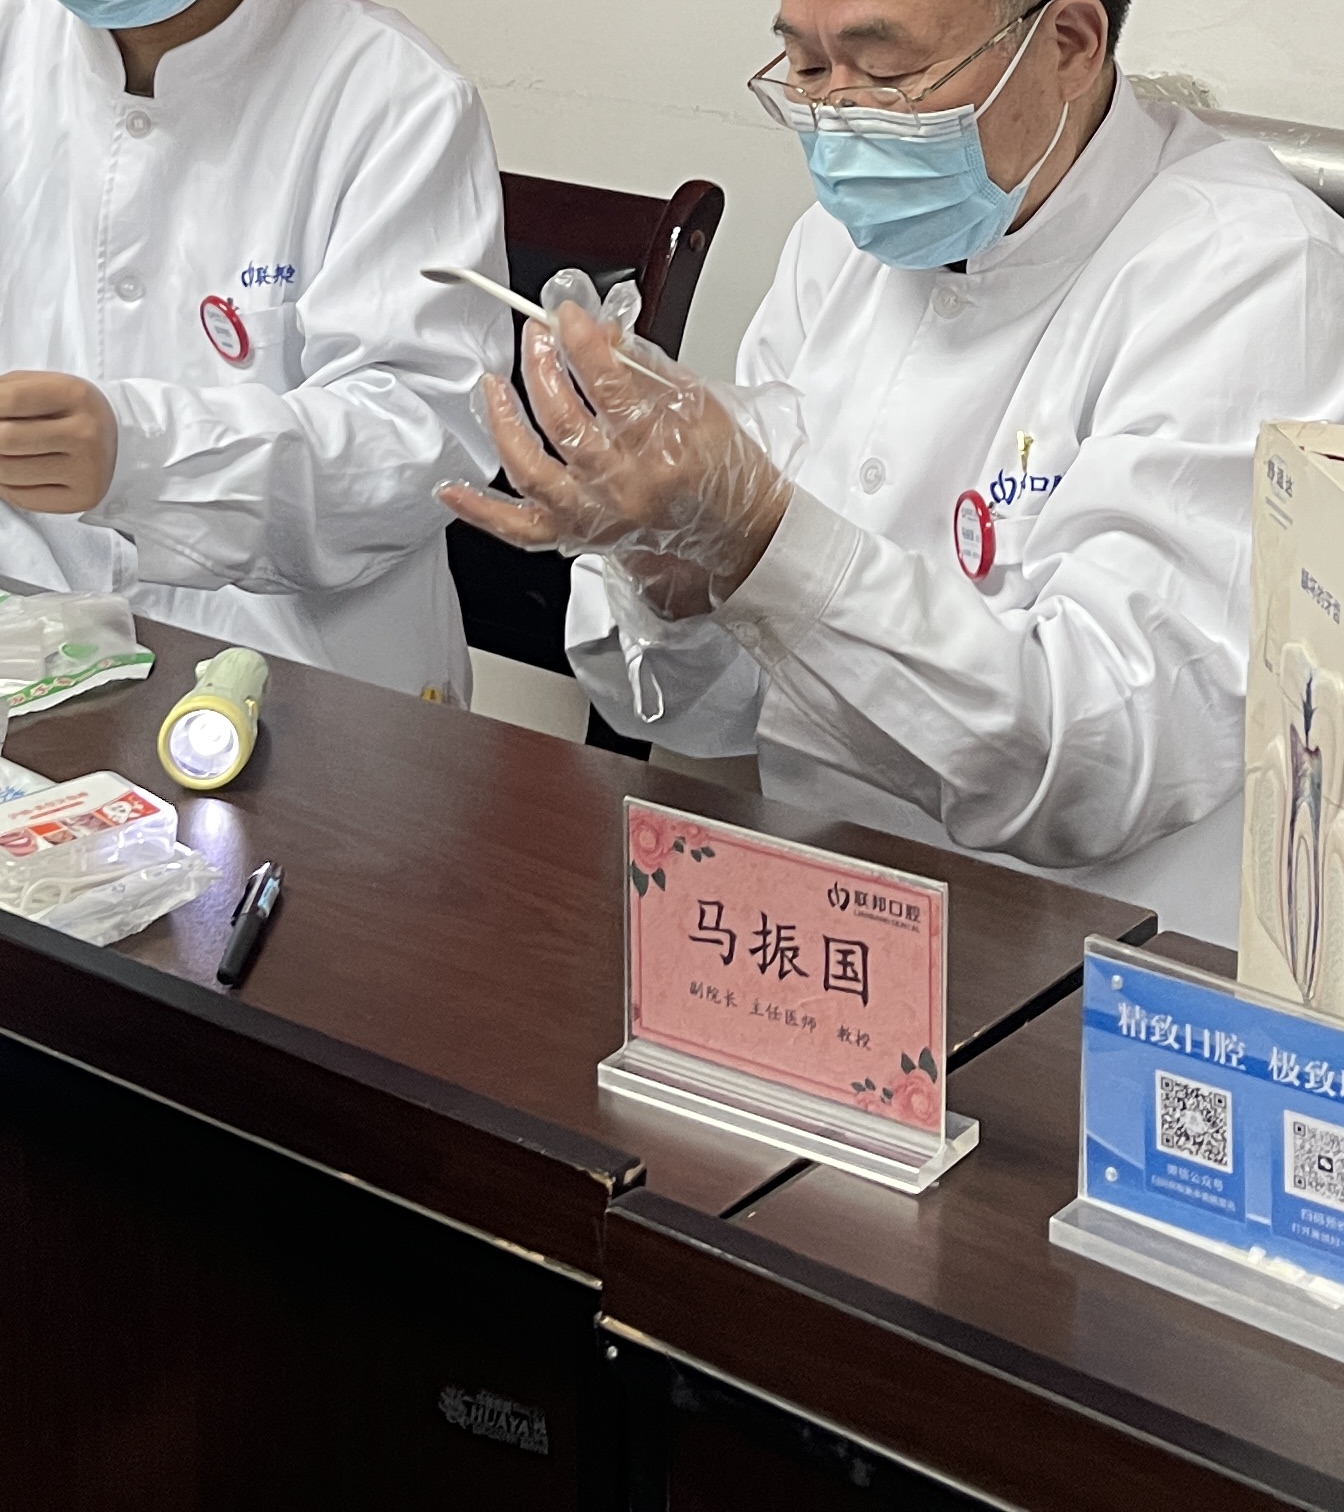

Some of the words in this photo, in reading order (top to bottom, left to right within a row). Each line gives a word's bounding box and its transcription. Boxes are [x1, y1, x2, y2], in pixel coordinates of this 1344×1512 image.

[688, 899, 870, 1009] 马振国
[690, 981, 738, 1008] 副院长
[749, 997, 817, 1033] 主任医师
[1117, 1002, 1247, 1071] 精致口腔
